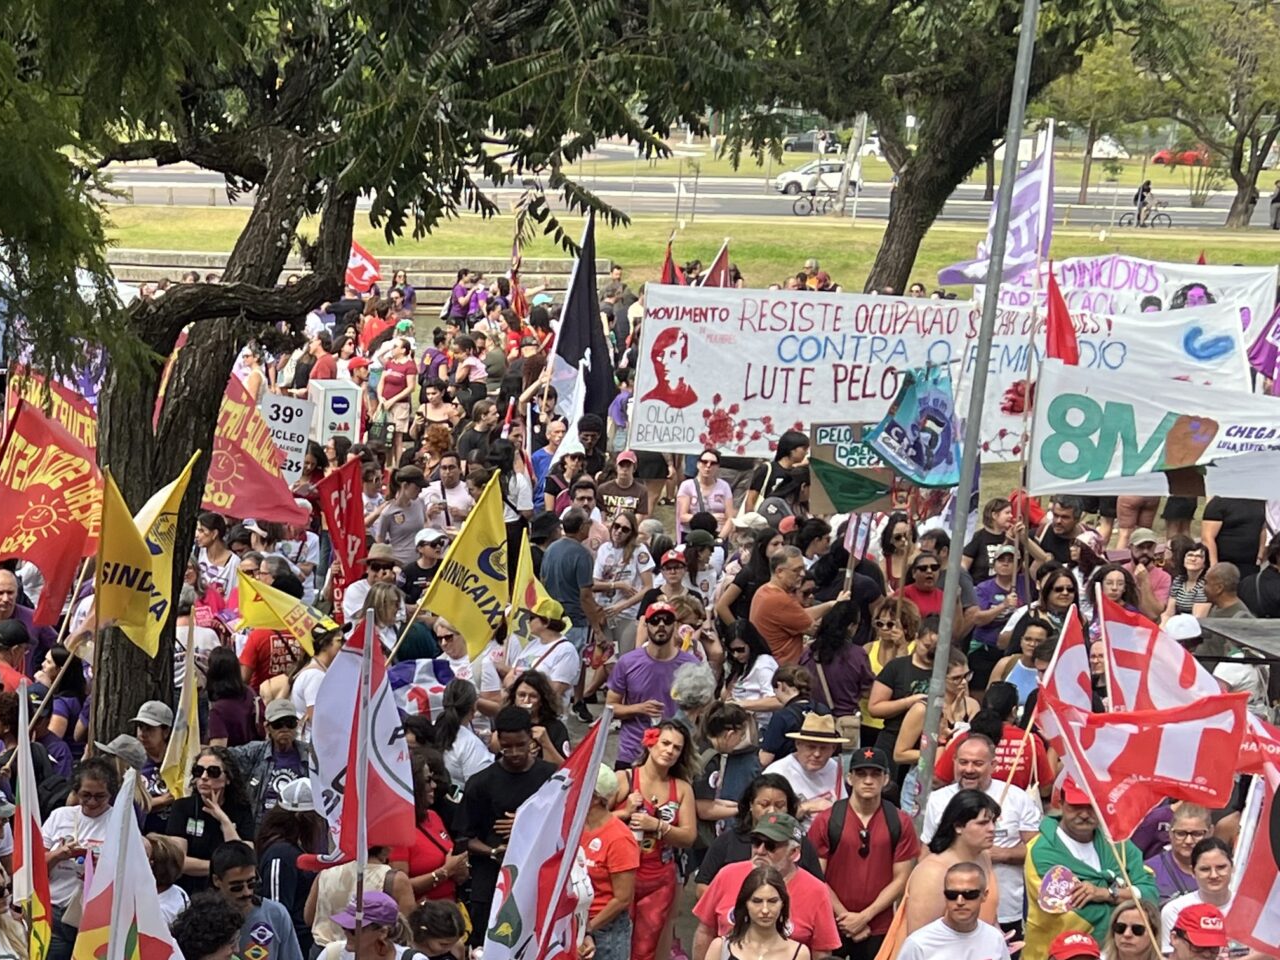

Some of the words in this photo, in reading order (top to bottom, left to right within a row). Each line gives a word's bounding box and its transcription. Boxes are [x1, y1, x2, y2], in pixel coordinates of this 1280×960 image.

[645, 304, 730, 324] MOVIMENTO
[738, 298, 843, 333] RESISTE
[854, 301, 960, 339] OCUPAÇÃO
[777, 333, 909, 365] CONTRA
[743, 361, 816, 405] LUTE
[833, 362, 900, 403] PELO
[646, 405, 685, 425] OLGA
[636, 424, 696, 444] BENARIO
[1040, 392, 1180, 483] 8M
[1225, 424, 1277, 440] CHEGA
